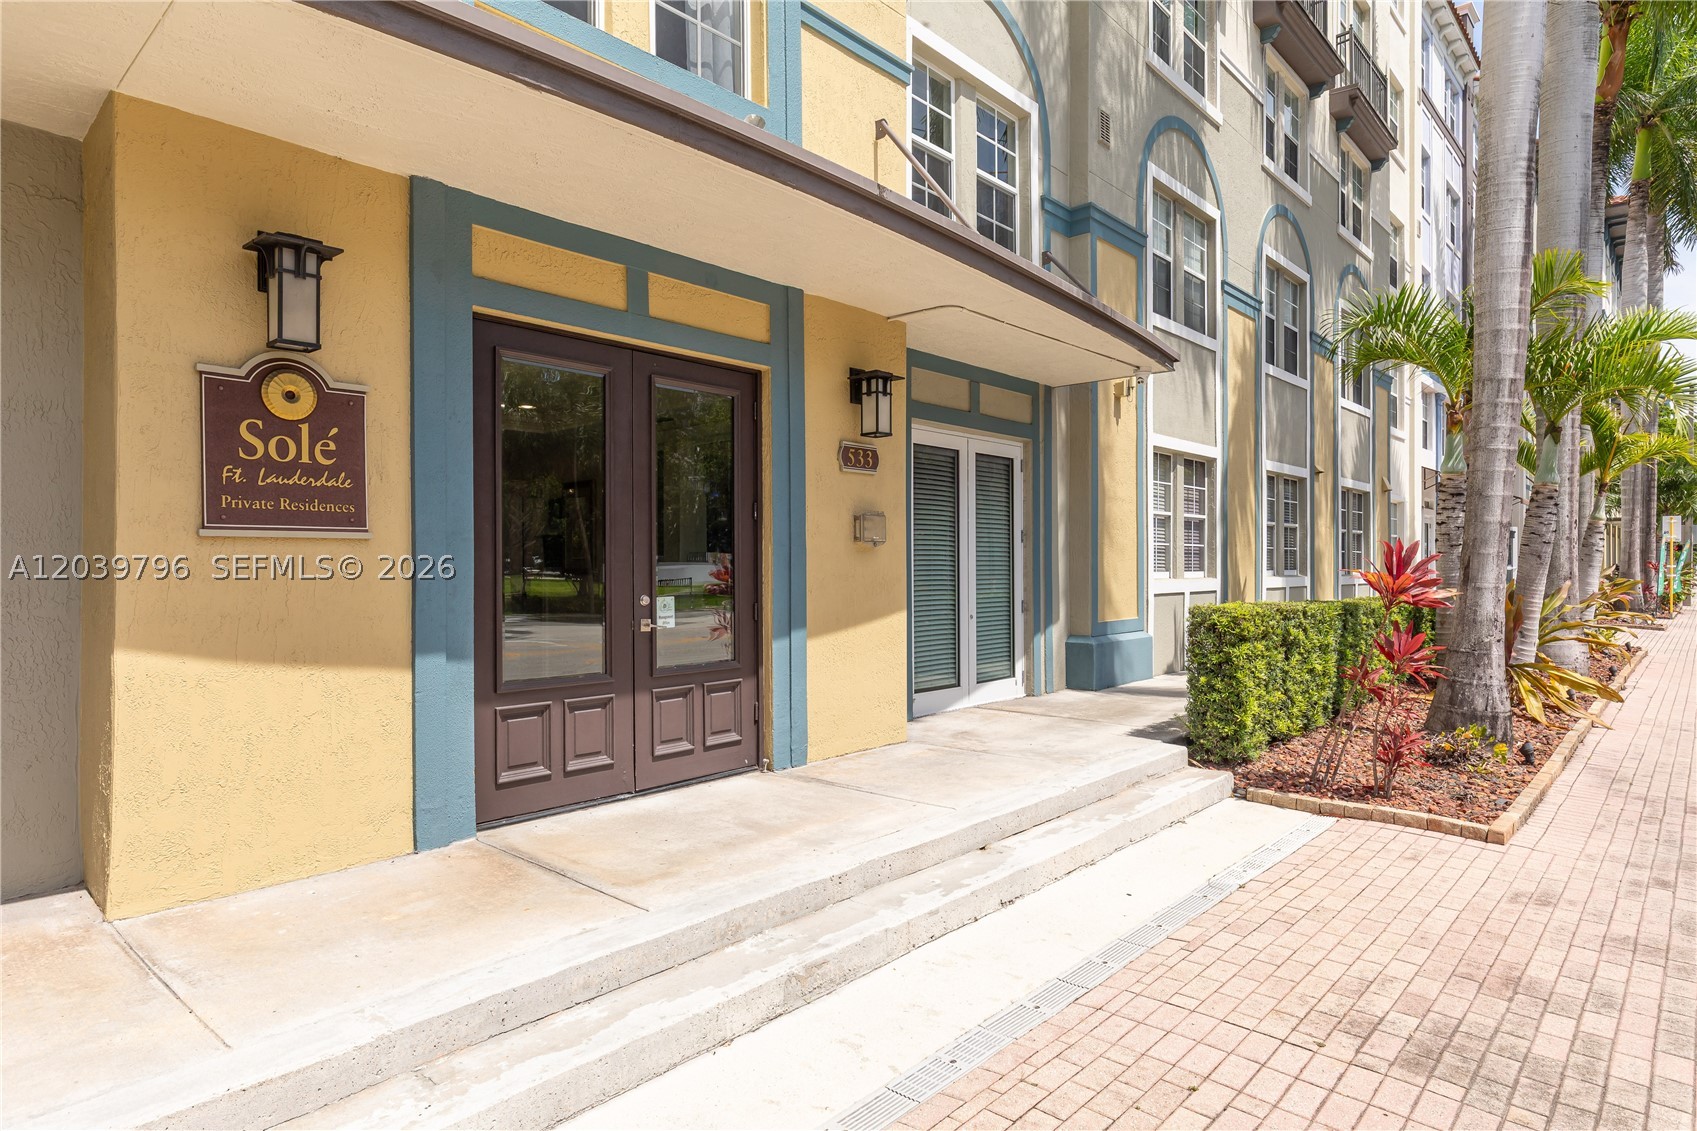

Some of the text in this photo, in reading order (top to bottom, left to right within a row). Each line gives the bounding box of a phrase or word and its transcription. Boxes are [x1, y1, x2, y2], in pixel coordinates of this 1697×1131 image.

[238, 418, 339, 466] Solé
[847, 448, 873, 469] 533
[221, 465, 354, 489] Ft. Lauderdale
[220, 495, 355, 513] Private Residences
